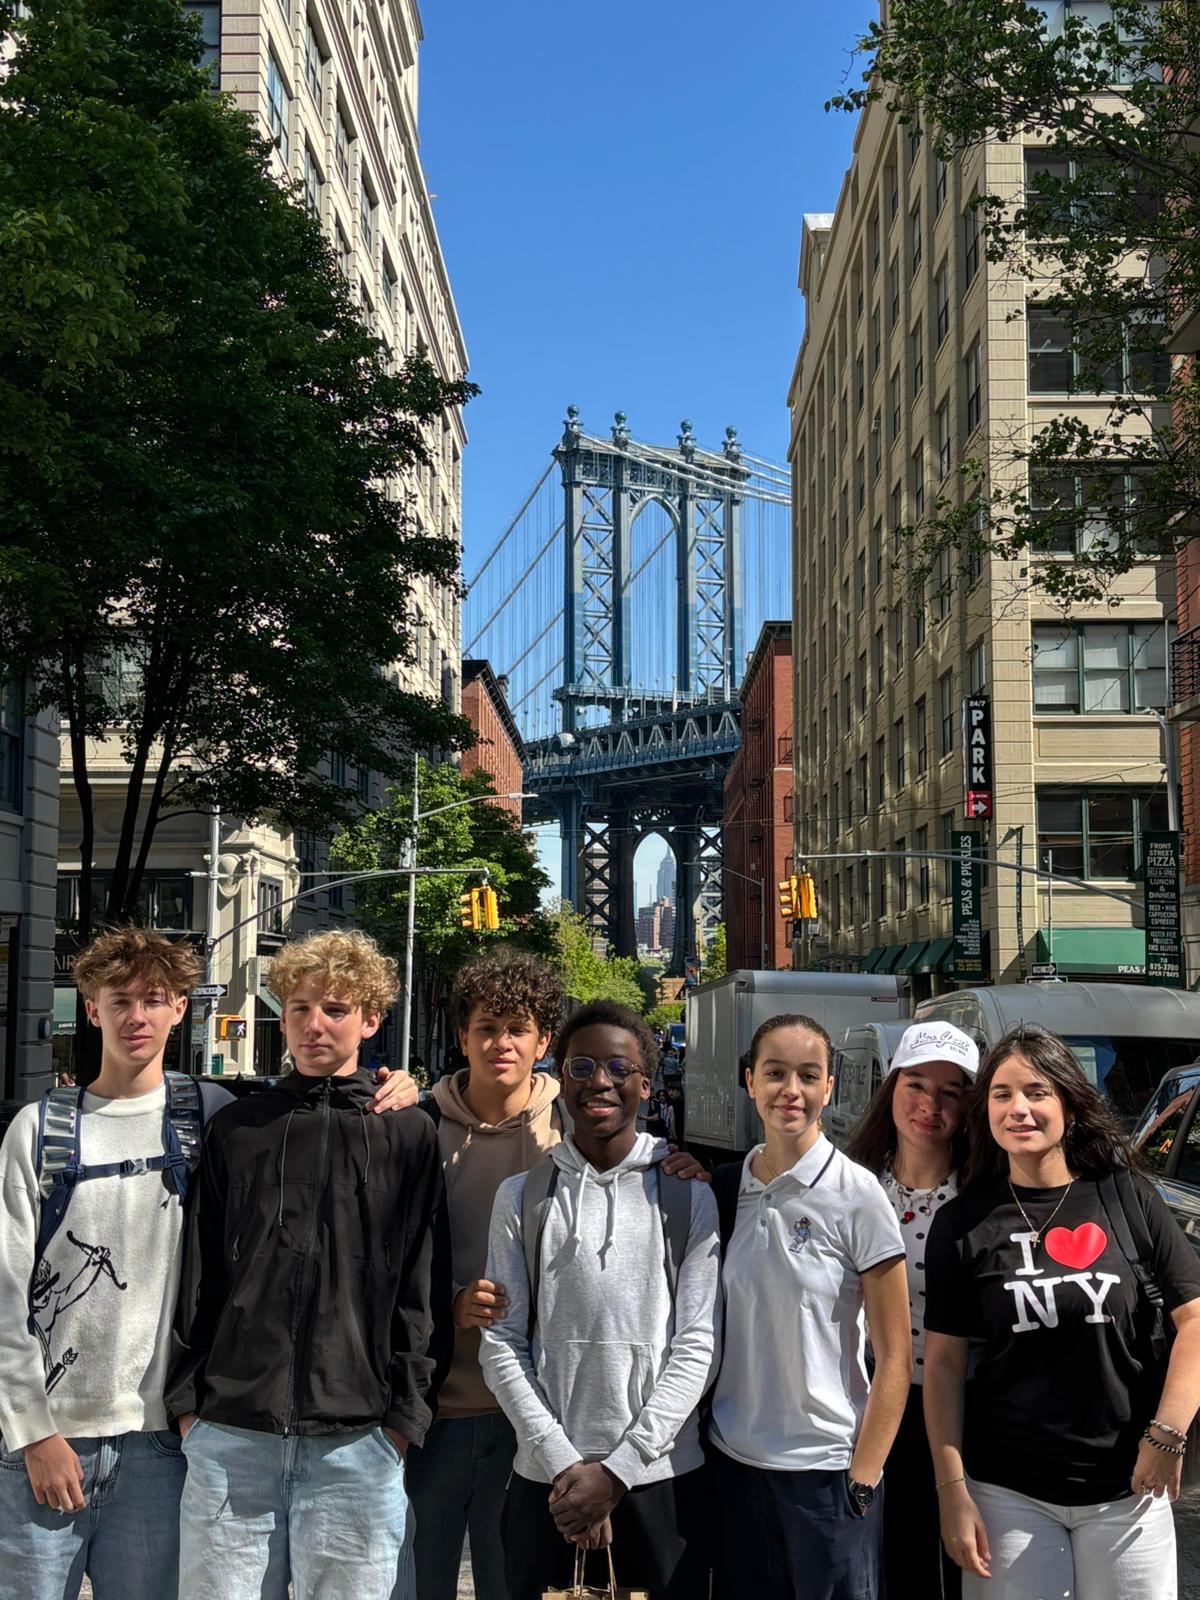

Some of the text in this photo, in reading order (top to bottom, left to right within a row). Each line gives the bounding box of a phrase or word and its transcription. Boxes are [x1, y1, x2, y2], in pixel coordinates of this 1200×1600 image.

[971, 709, 986, 784] PARK
[960, 835, 972, 876] PICKLES
[1147, 856, 1176, 867] PIZZA
[961, 878, 973, 888] &
[961, 889, 973, 915] PEAS
[1118, 965, 1140, 974] PEAS
[1149, 963, 1179, 971] 875-3700
[1010, 1231, 1044, 1276] I
[1004, 1272, 1121, 1333] NY
